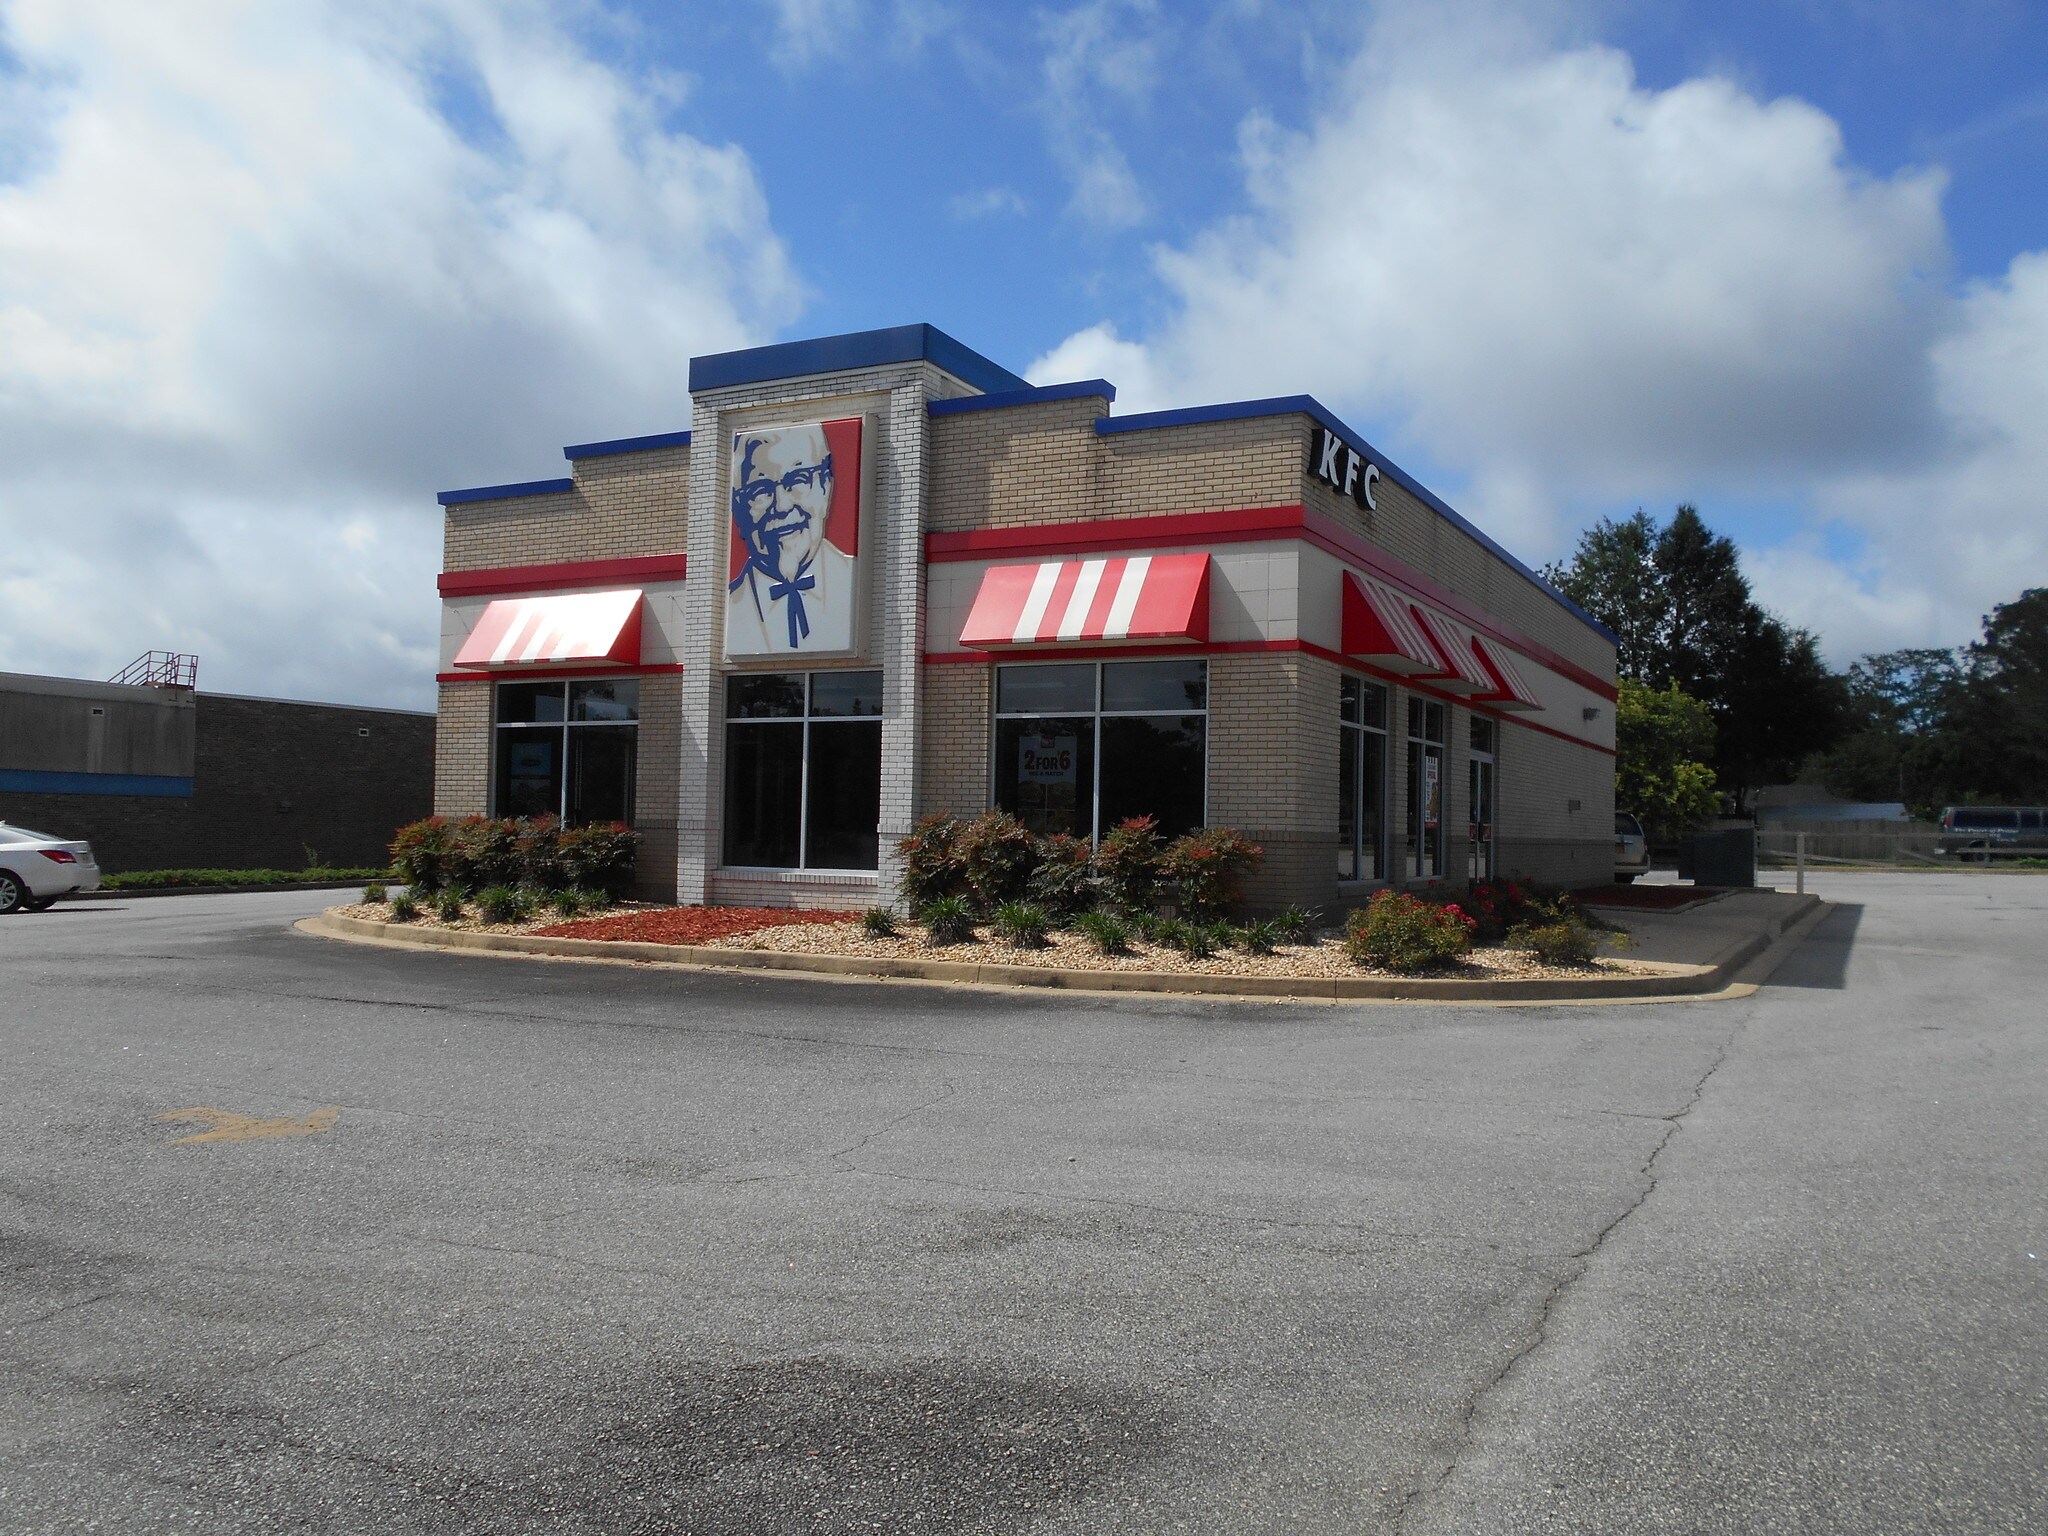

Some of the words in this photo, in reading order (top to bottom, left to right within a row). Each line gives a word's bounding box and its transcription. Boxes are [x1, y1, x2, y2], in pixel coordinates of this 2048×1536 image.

[1318, 428, 1380, 511] KFC
[1024, 749, 1035, 770] 2
[1036, 756, 1058, 770] FOR
